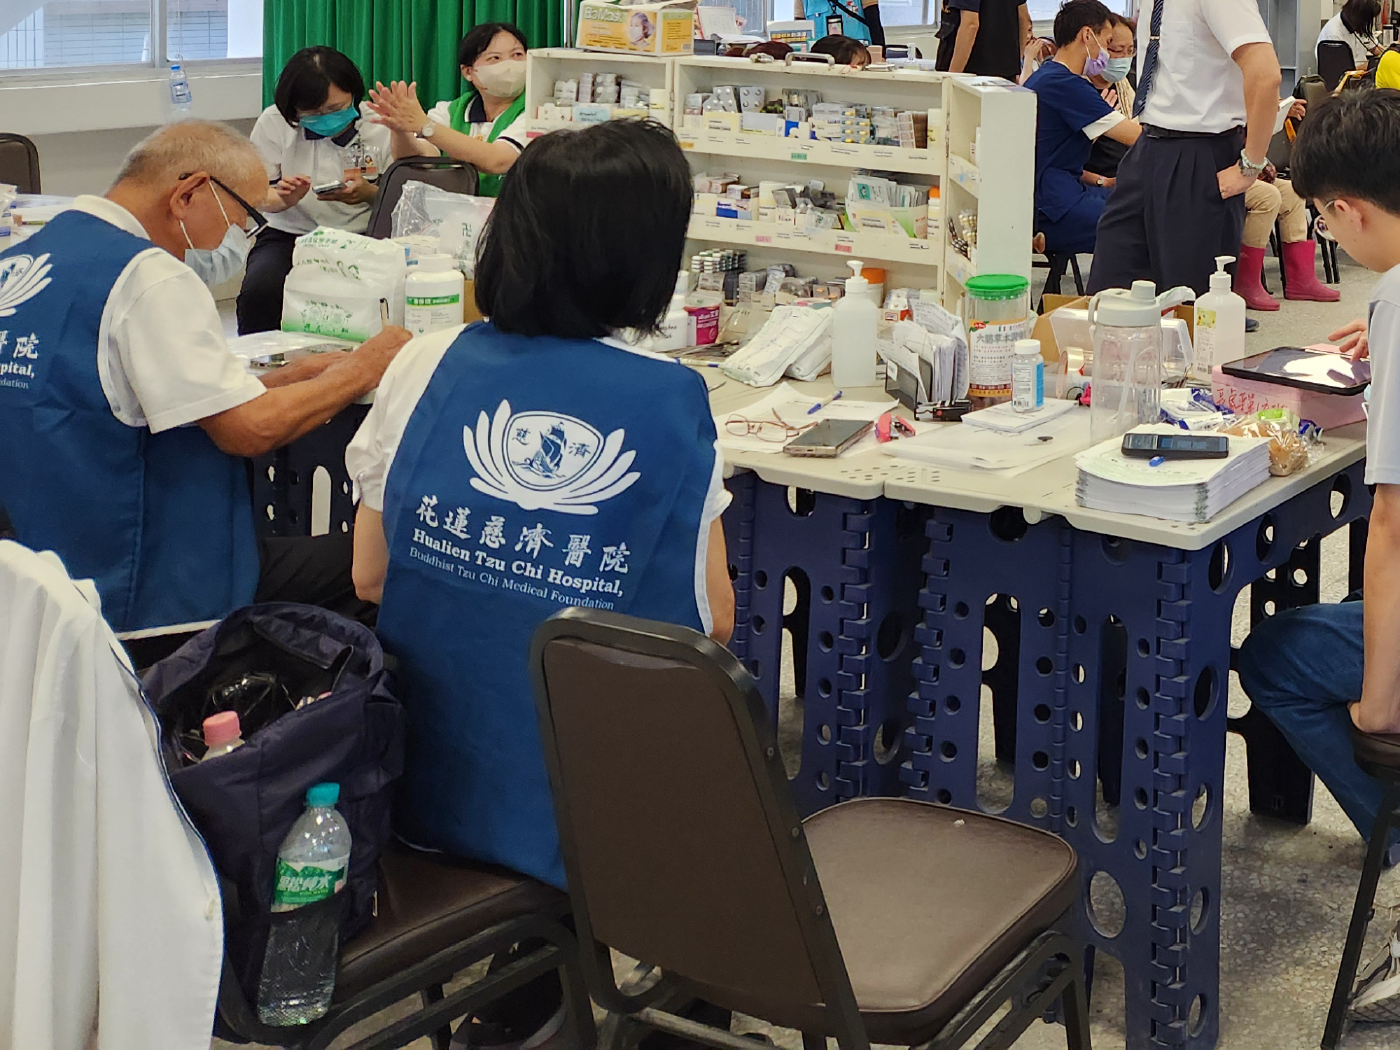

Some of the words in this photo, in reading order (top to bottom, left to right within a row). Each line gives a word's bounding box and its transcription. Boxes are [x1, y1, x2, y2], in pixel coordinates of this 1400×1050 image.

[412, 528, 471, 562] Hualien
[474, 550, 506, 572] Tzu
[511, 560, 543, 580] Chi
[547, 568, 625, 598] Hospital,
[415, 494, 631, 574] 花蓮慈濟醫院
[409, 546, 455, 573] Buddhist
[457, 565, 476, 580] Tzu
[479, 572, 499, 587] Chi
[501, 578, 548, 599] Medical
[550, 590, 615, 611] Foundation
